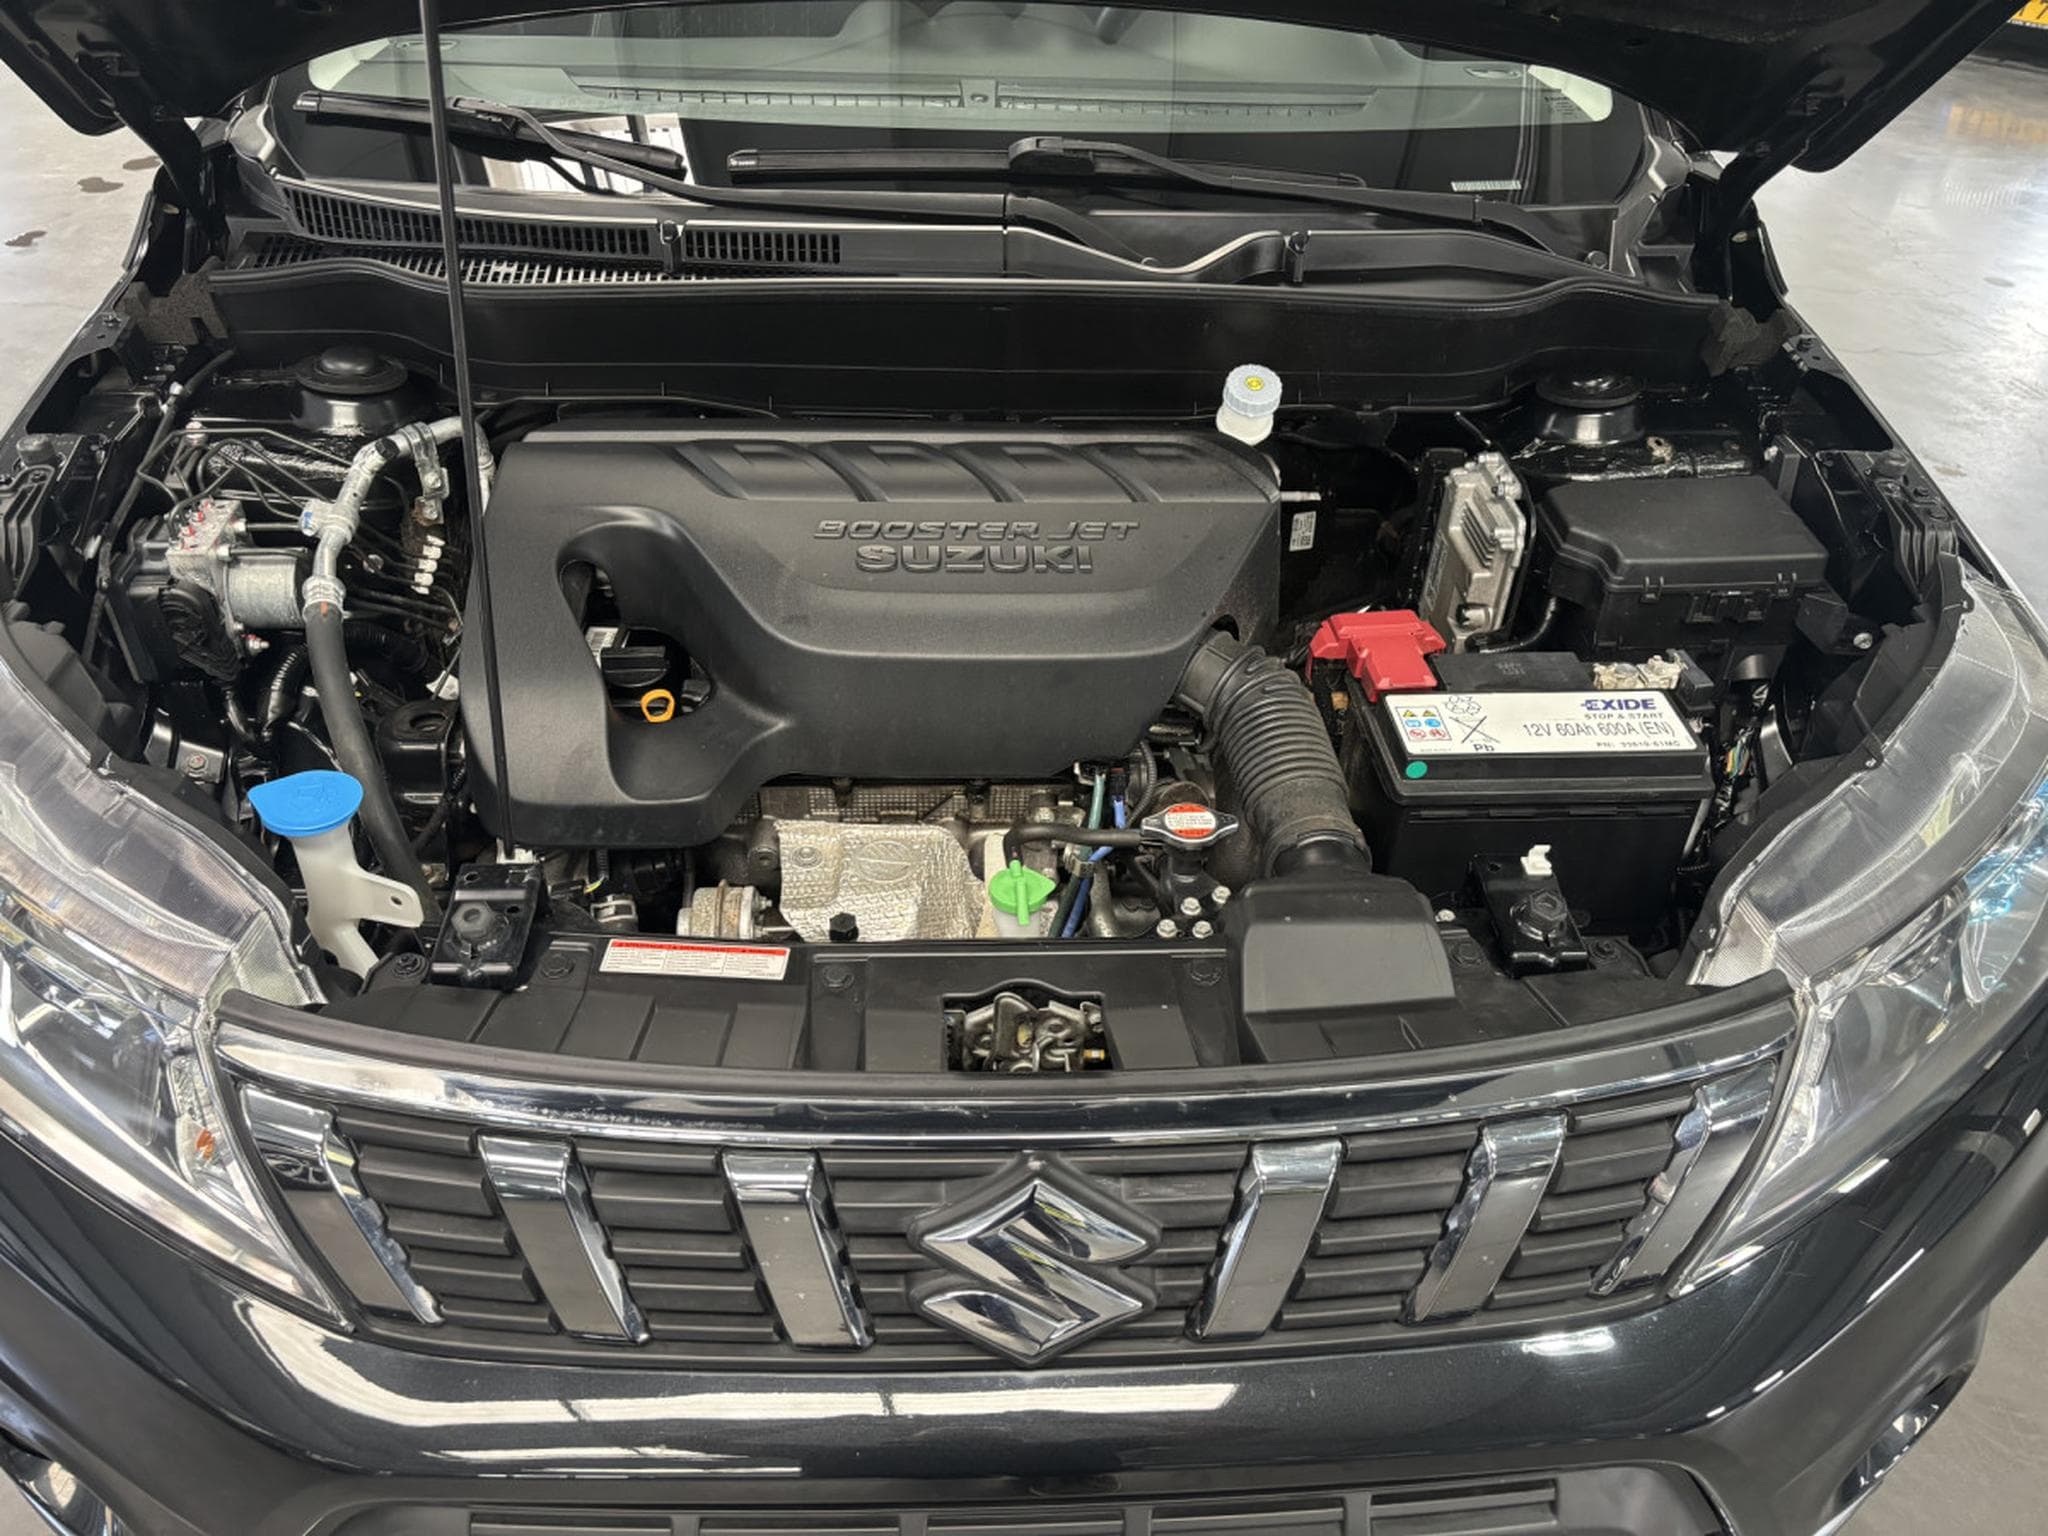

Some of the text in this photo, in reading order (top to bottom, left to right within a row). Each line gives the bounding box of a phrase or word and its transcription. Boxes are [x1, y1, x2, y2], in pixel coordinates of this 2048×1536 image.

[814, 519, 1140, 541] BOOSTER JET
[855, 544, 1093, 575] SUZUKI
[1581, 698, 1657, 711] EXIDE
[1584, 712, 1614, 720] STOP
[1629, 712, 1664, 720] START
[1523, 721, 1676, 738] 12V 60Ah 600A (EN)
[1473, 743, 1495, 752] Pb
